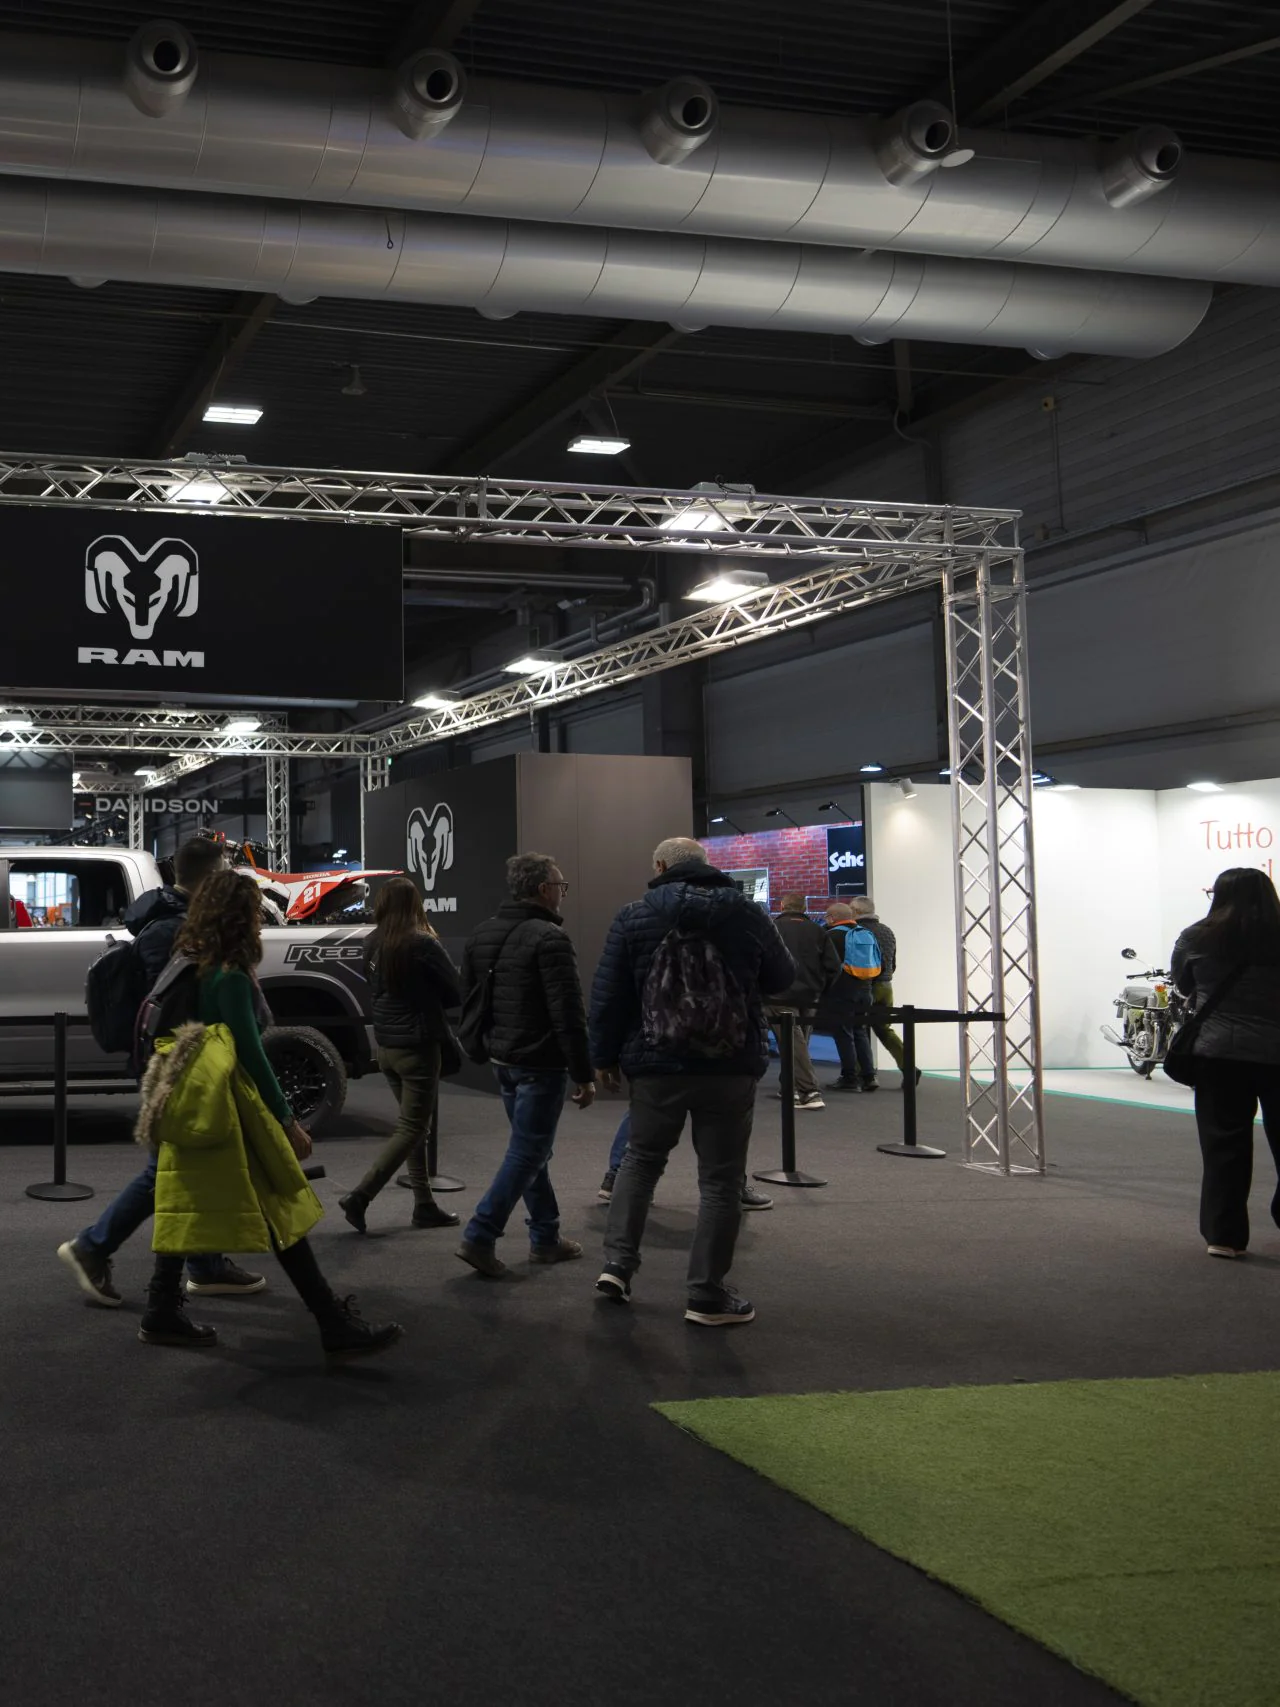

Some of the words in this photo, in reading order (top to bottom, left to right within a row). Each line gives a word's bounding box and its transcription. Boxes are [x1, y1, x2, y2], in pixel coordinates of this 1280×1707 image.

[77, 646, 205, 668] RAM
[1200, 820, 1273, 850] Tutto
[303, 872, 331, 880] HONDA
[303, 882, 321, 904] 21
[423, 897, 457, 912] AM
